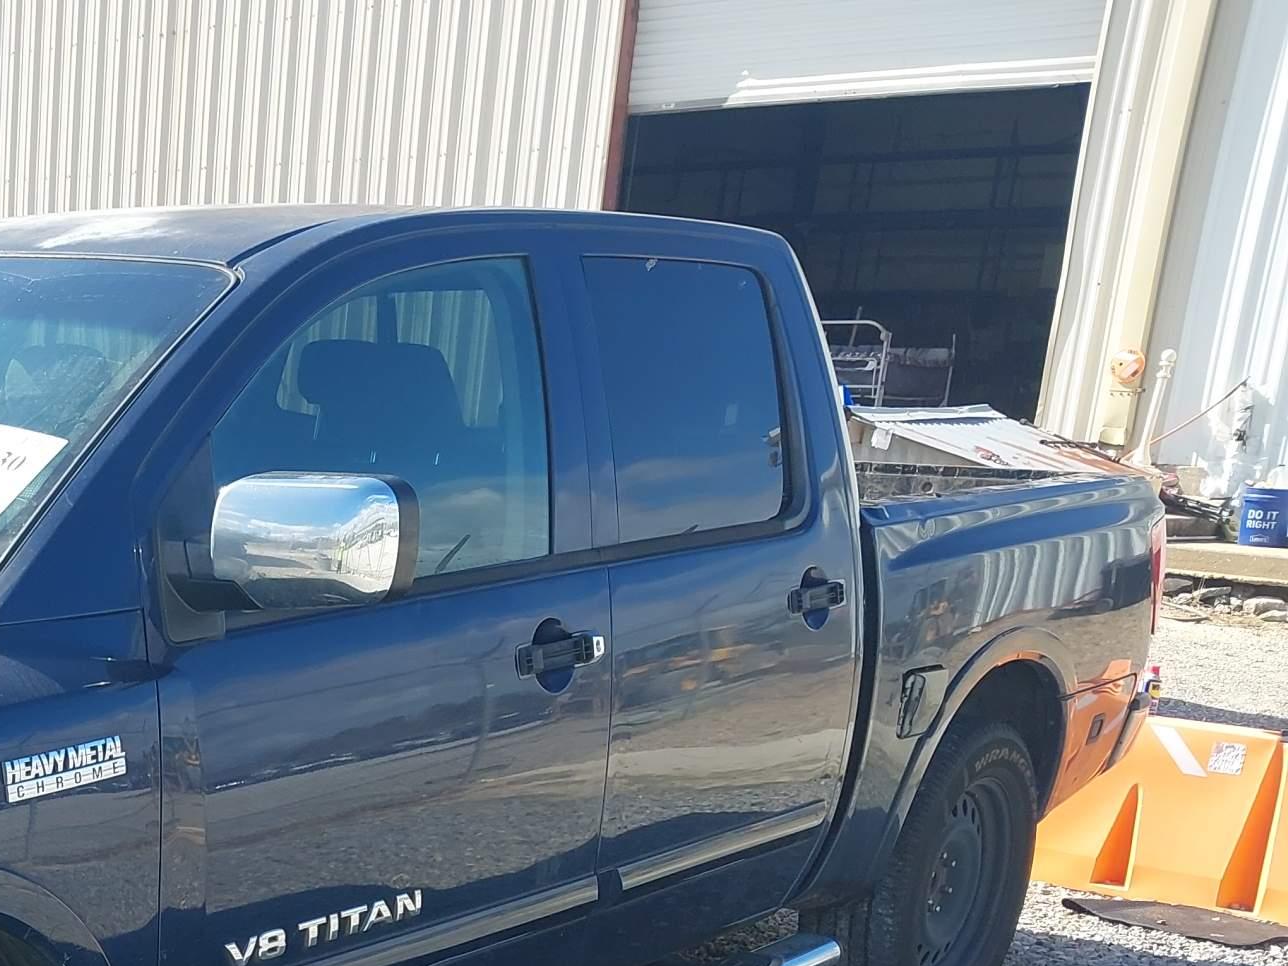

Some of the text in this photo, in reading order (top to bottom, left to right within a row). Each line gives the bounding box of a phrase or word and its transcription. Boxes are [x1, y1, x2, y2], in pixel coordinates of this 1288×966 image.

[1245, 519, 1278, 529] RIGHT
[1247, 509, 1280, 521] DO IT
[4, 735, 126, 785] HEAVY METAL
[298, 889, 423, 948] TITAN
